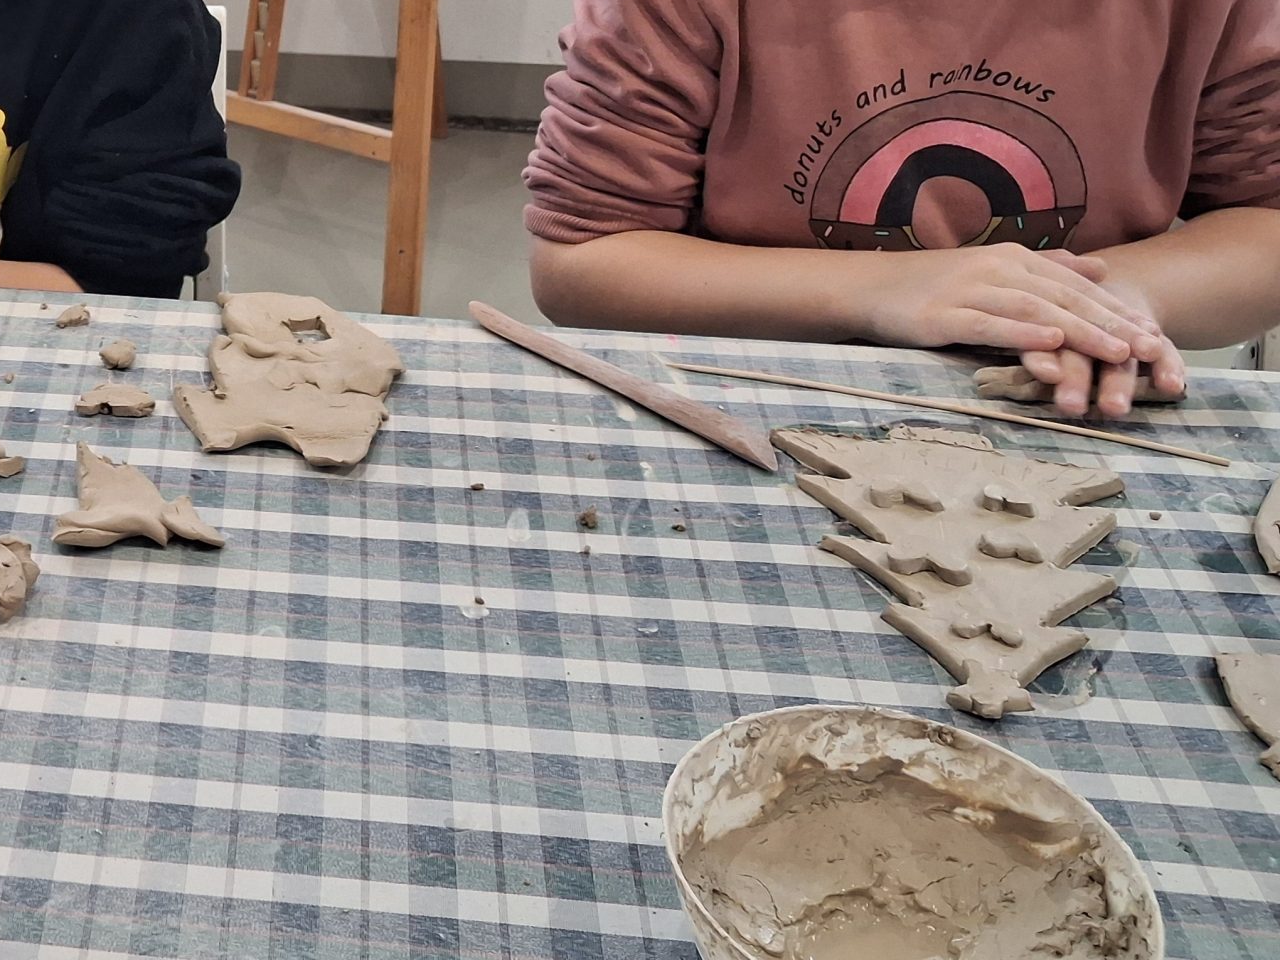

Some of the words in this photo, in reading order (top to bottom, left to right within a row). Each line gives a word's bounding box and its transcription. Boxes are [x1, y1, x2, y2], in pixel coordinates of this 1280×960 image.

[783, 108, 843, 206] donuts
[855, 68, 907, 110] and
[928, 58, 1056, 104] rainbows
